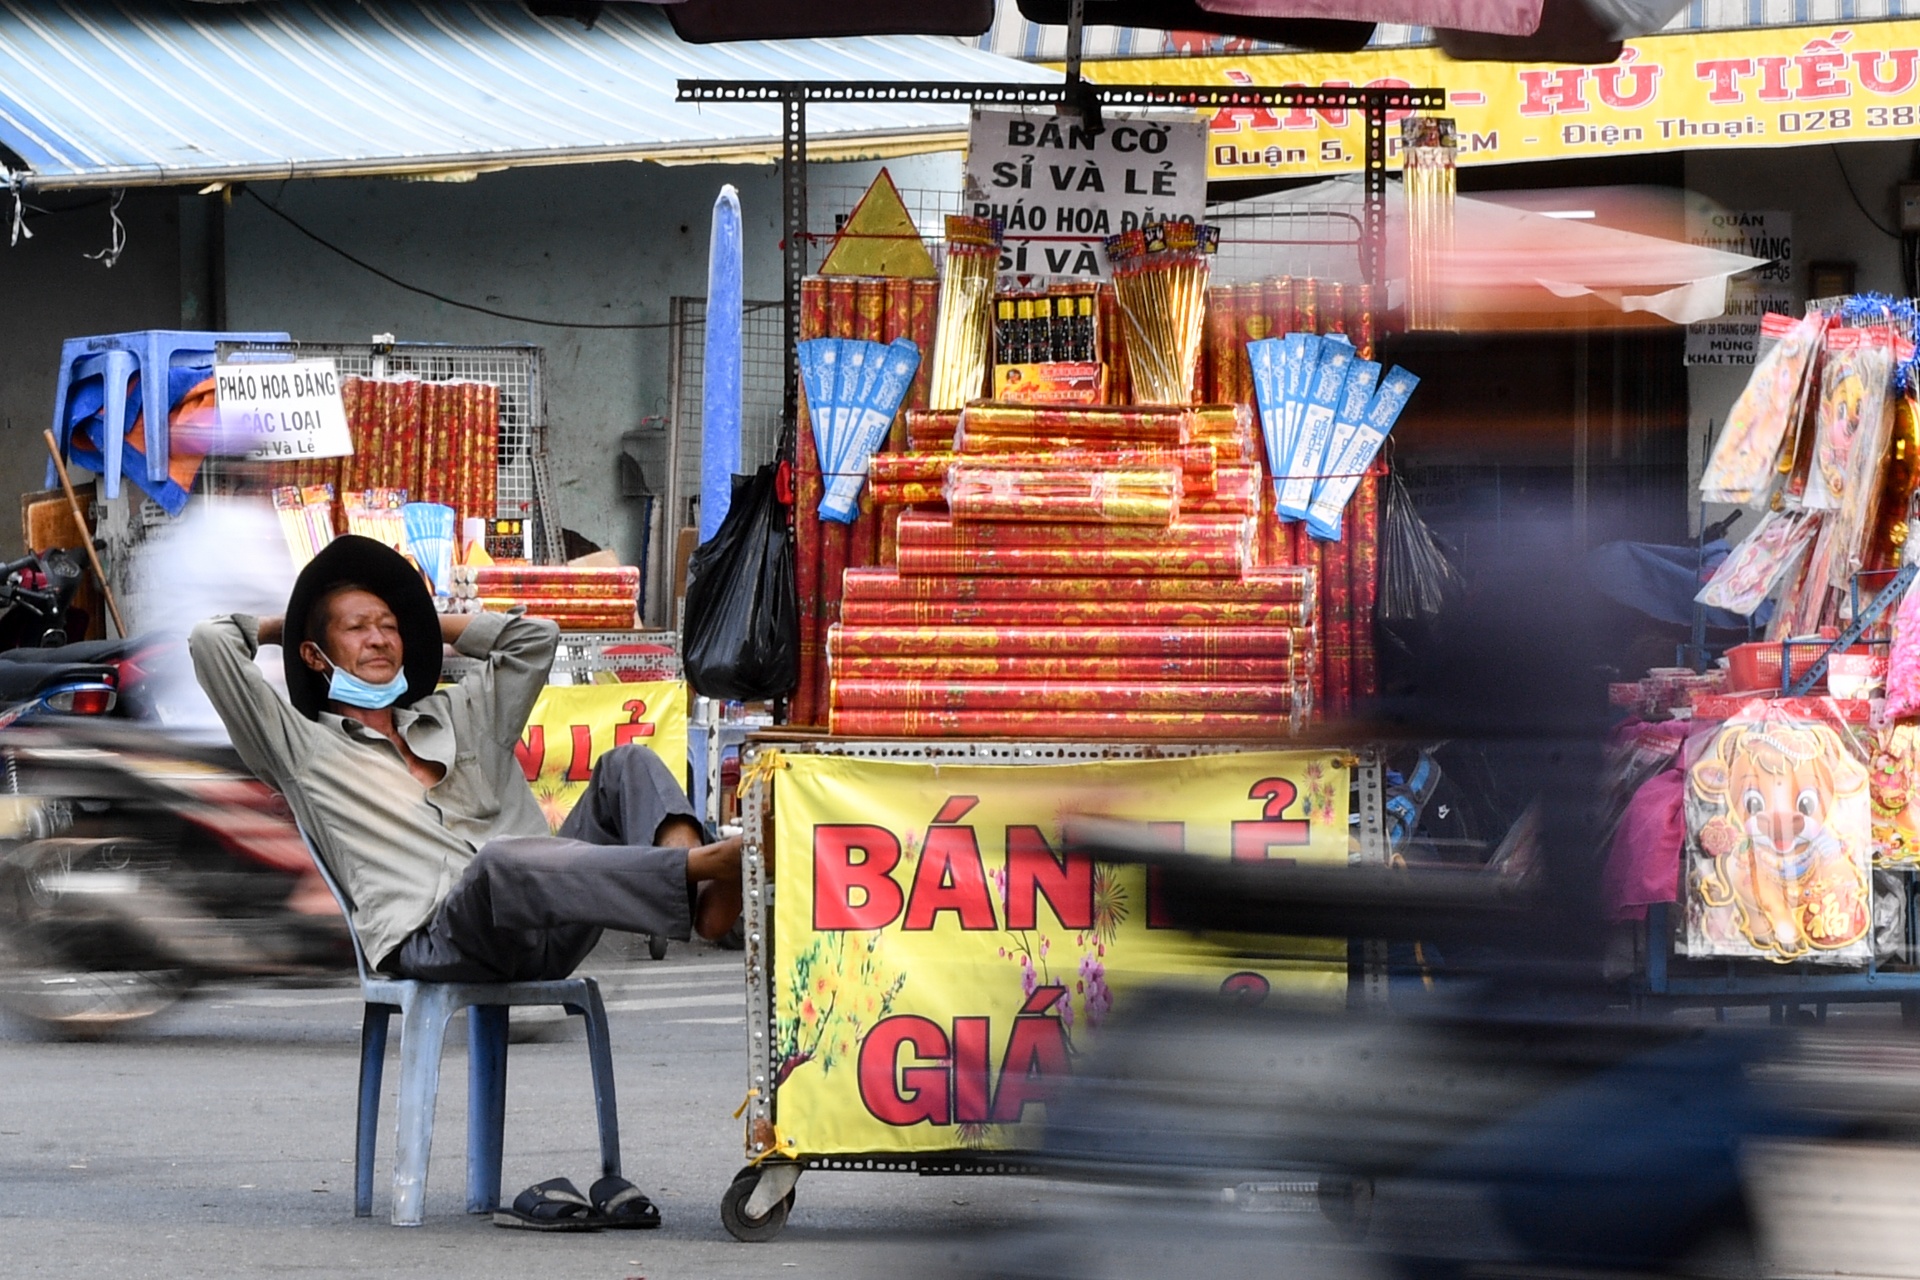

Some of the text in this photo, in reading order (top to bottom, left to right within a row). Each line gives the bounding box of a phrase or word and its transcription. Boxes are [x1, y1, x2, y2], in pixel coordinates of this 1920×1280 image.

[1519, 47, 1663, 115] HỦ
[1696, 31, 1920, 104] TIẾU
[1008, 117, 1171, 154] BÁN CỜ
[1215, 145, 1306, 167] Quận
[1320, 140, 1353, 162] 5,
[1562, 123, 1643, 146] Điện
[1657, 114, 1765, 138] Thoại:
[1779, 109, 1851, 132] 028
[1867, 105, 1920, 127] 38
[991, 154, 1177, 197] SỈ VÀ LẺ
[1056, 206, 1110, 234] HOA
[1712, 213, 1765, 228] QUÁN
[1045, 242, 1100, 276] VÀ
[1750, 230, 1790, 260] VÀNG
[1688, 353, 1758, 364] KHAI TRƯ
[1710, 337, 1753, 351] MÙNG
[219, 368, 336, 400] PHÁO HOA ĐĂNG
[281, 410, 321, 435] LOẠI
[272, 440, 292, 455] Và
[813, 795, 1095, 931] BÁN
